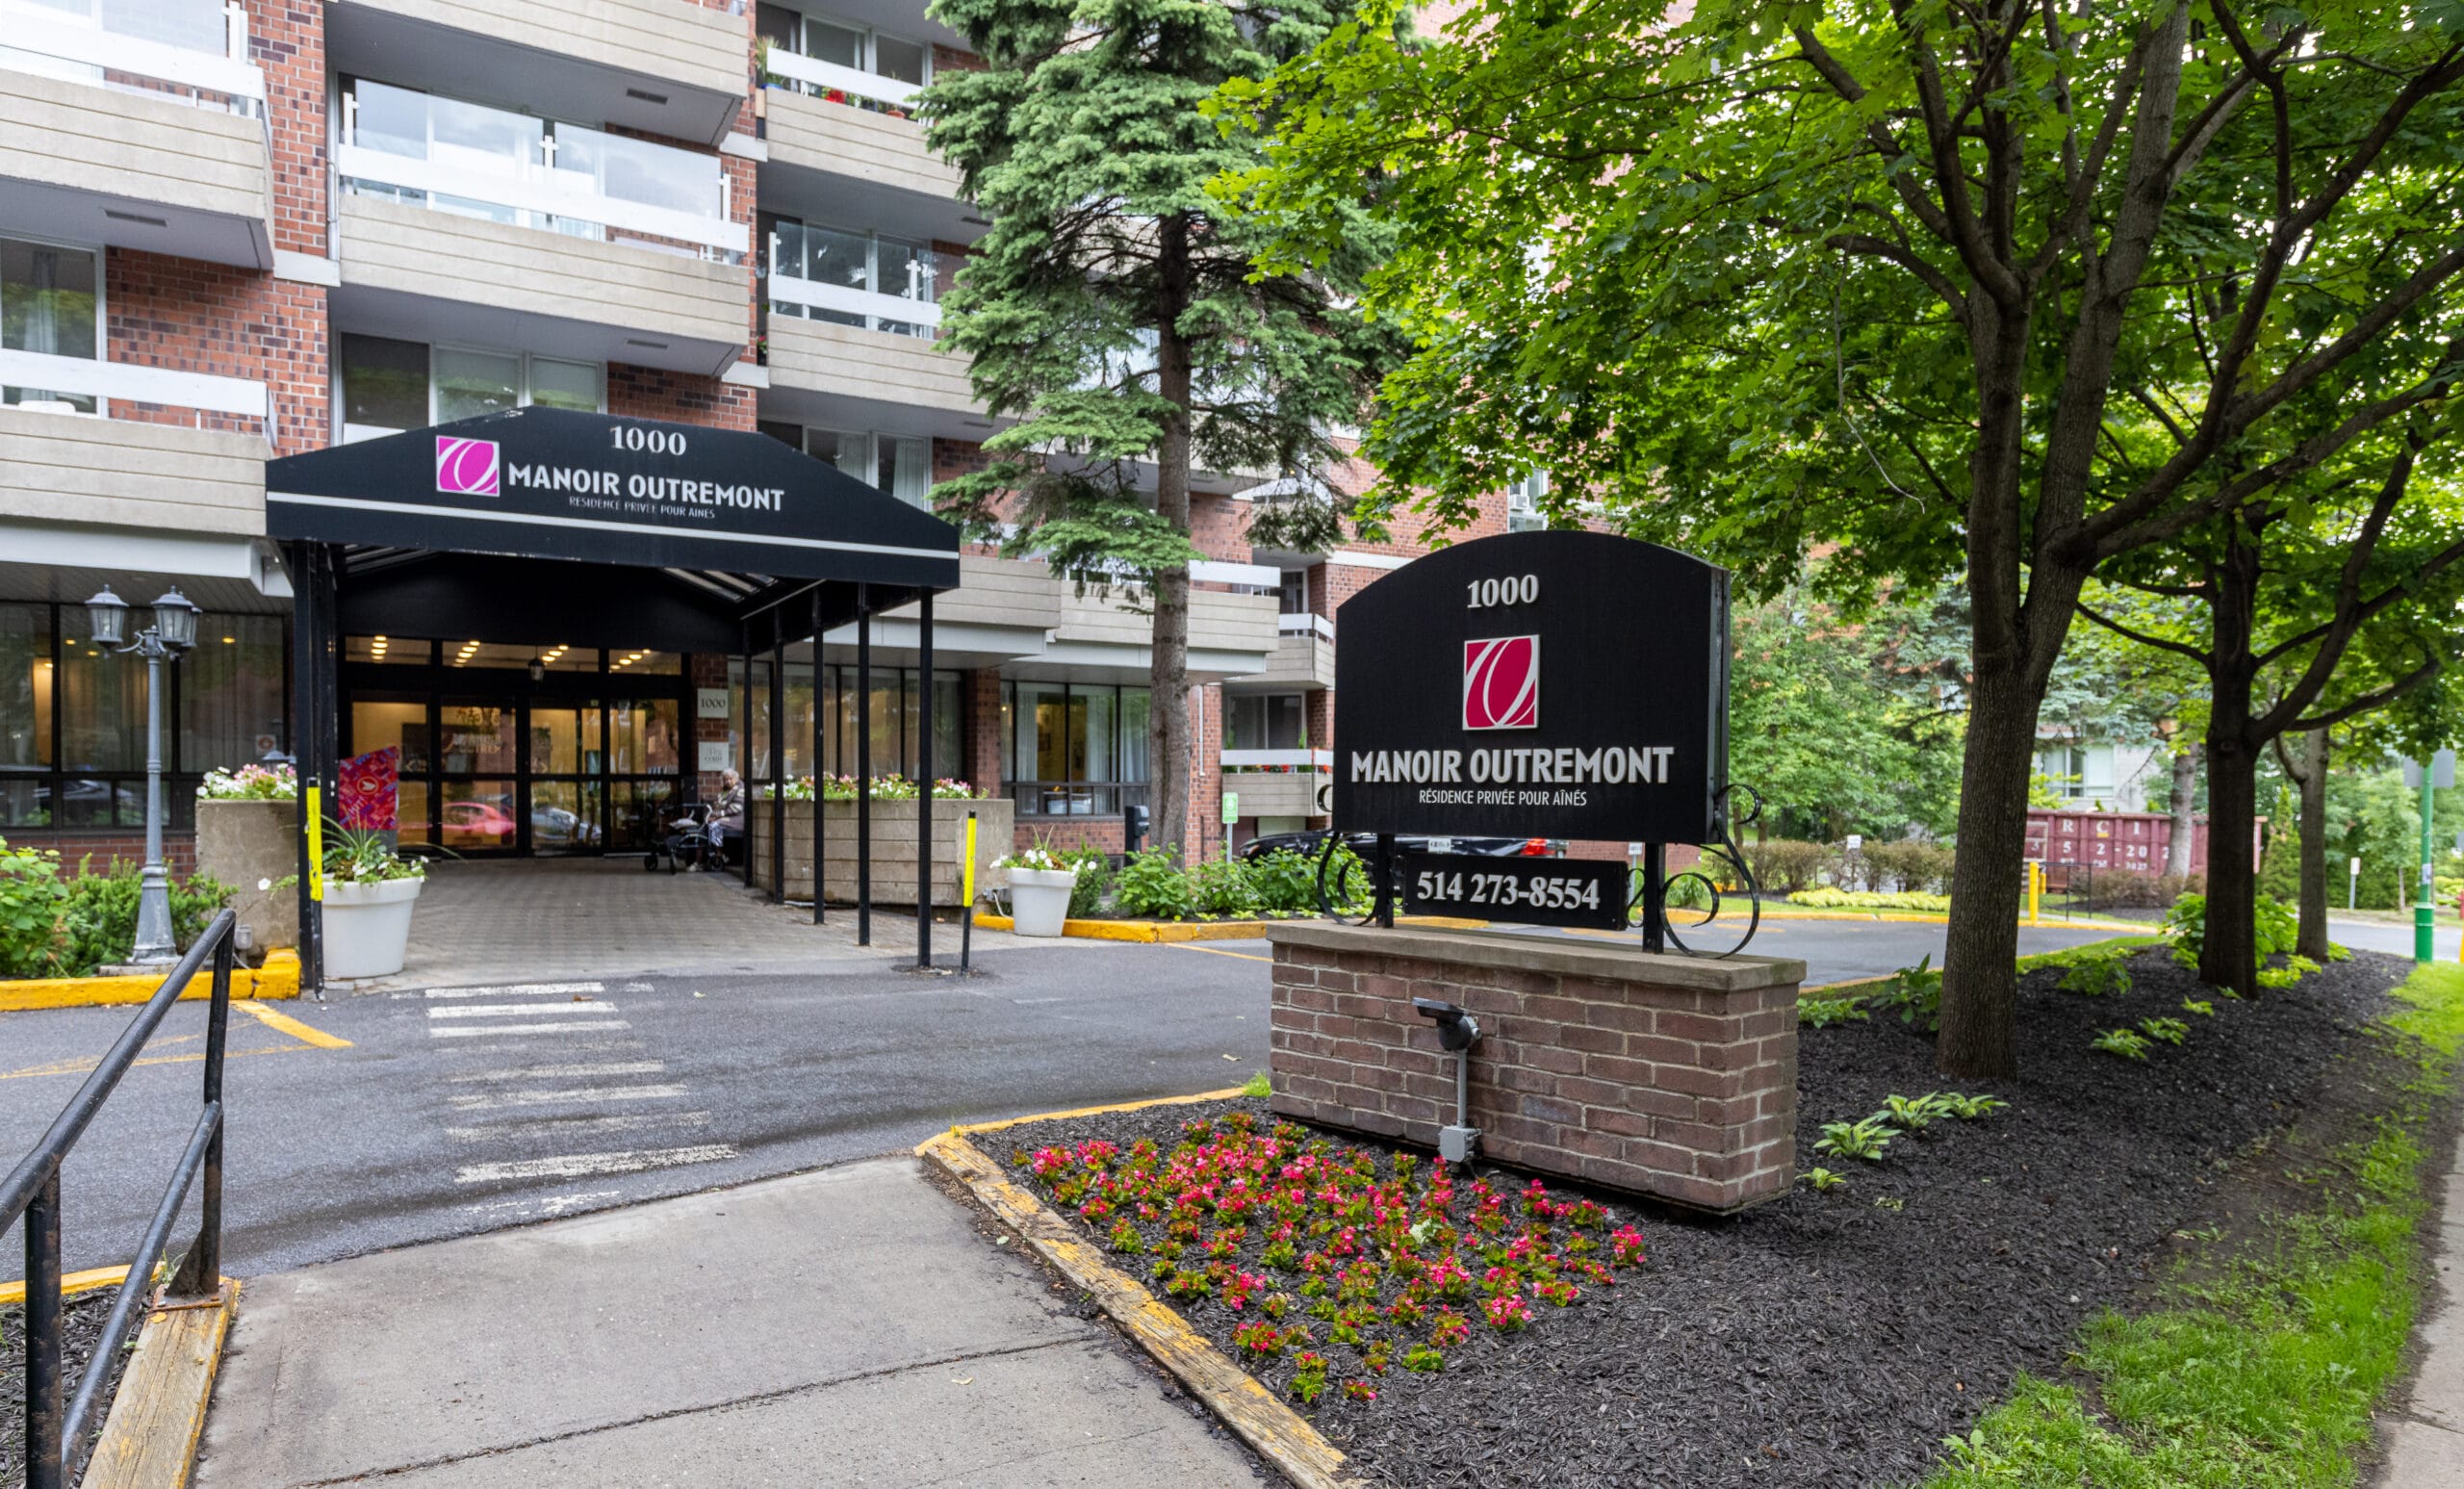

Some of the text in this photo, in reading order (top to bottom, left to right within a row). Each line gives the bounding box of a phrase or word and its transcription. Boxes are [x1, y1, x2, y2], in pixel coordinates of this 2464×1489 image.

[609, 425, 687, 456] 1000
[508, 462, 784, 511] MANOIR OUTREMONT
[660, 504, 686, 517] POUR
[1467, 574, 1539, 609] 1000
[701, 698, 726, 708] 1000
[1350, 746, 1675, 784] MANOIR OUTREMONT
[1419, 787, 1587, 807] RÉSIDENCE PRIVÉE POUR AÎNÉS
[1417, 871, 1601, 911] 514 273-8554
